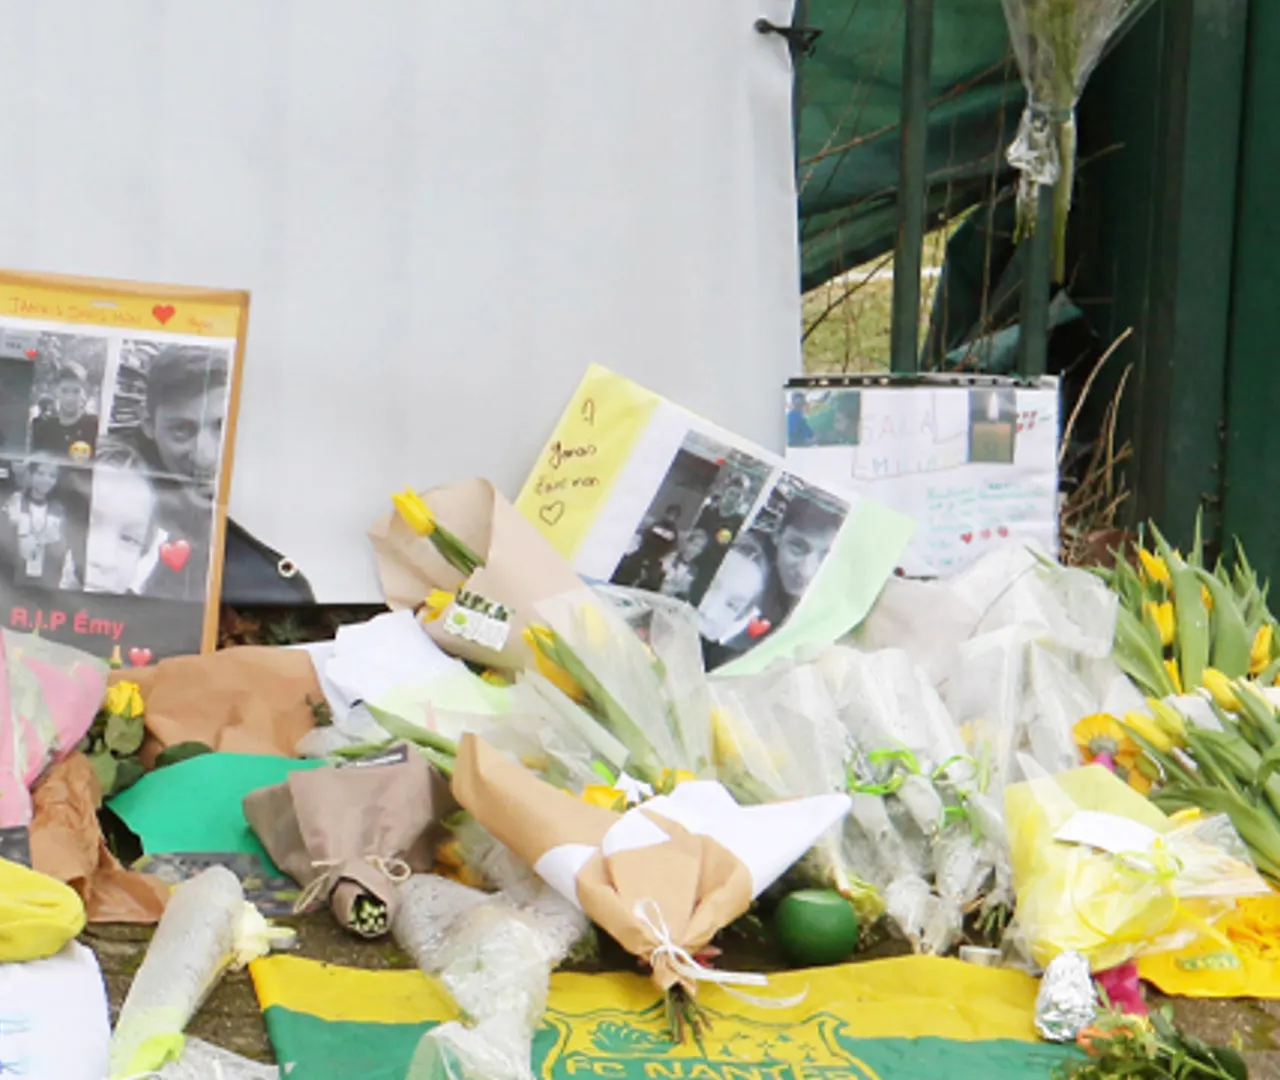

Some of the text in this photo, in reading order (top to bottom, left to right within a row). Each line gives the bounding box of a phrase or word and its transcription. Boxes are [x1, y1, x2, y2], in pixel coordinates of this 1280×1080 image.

[9, 606, 127, 642] R.I.P Émy
[565, 1055, 629, 1079] FC
